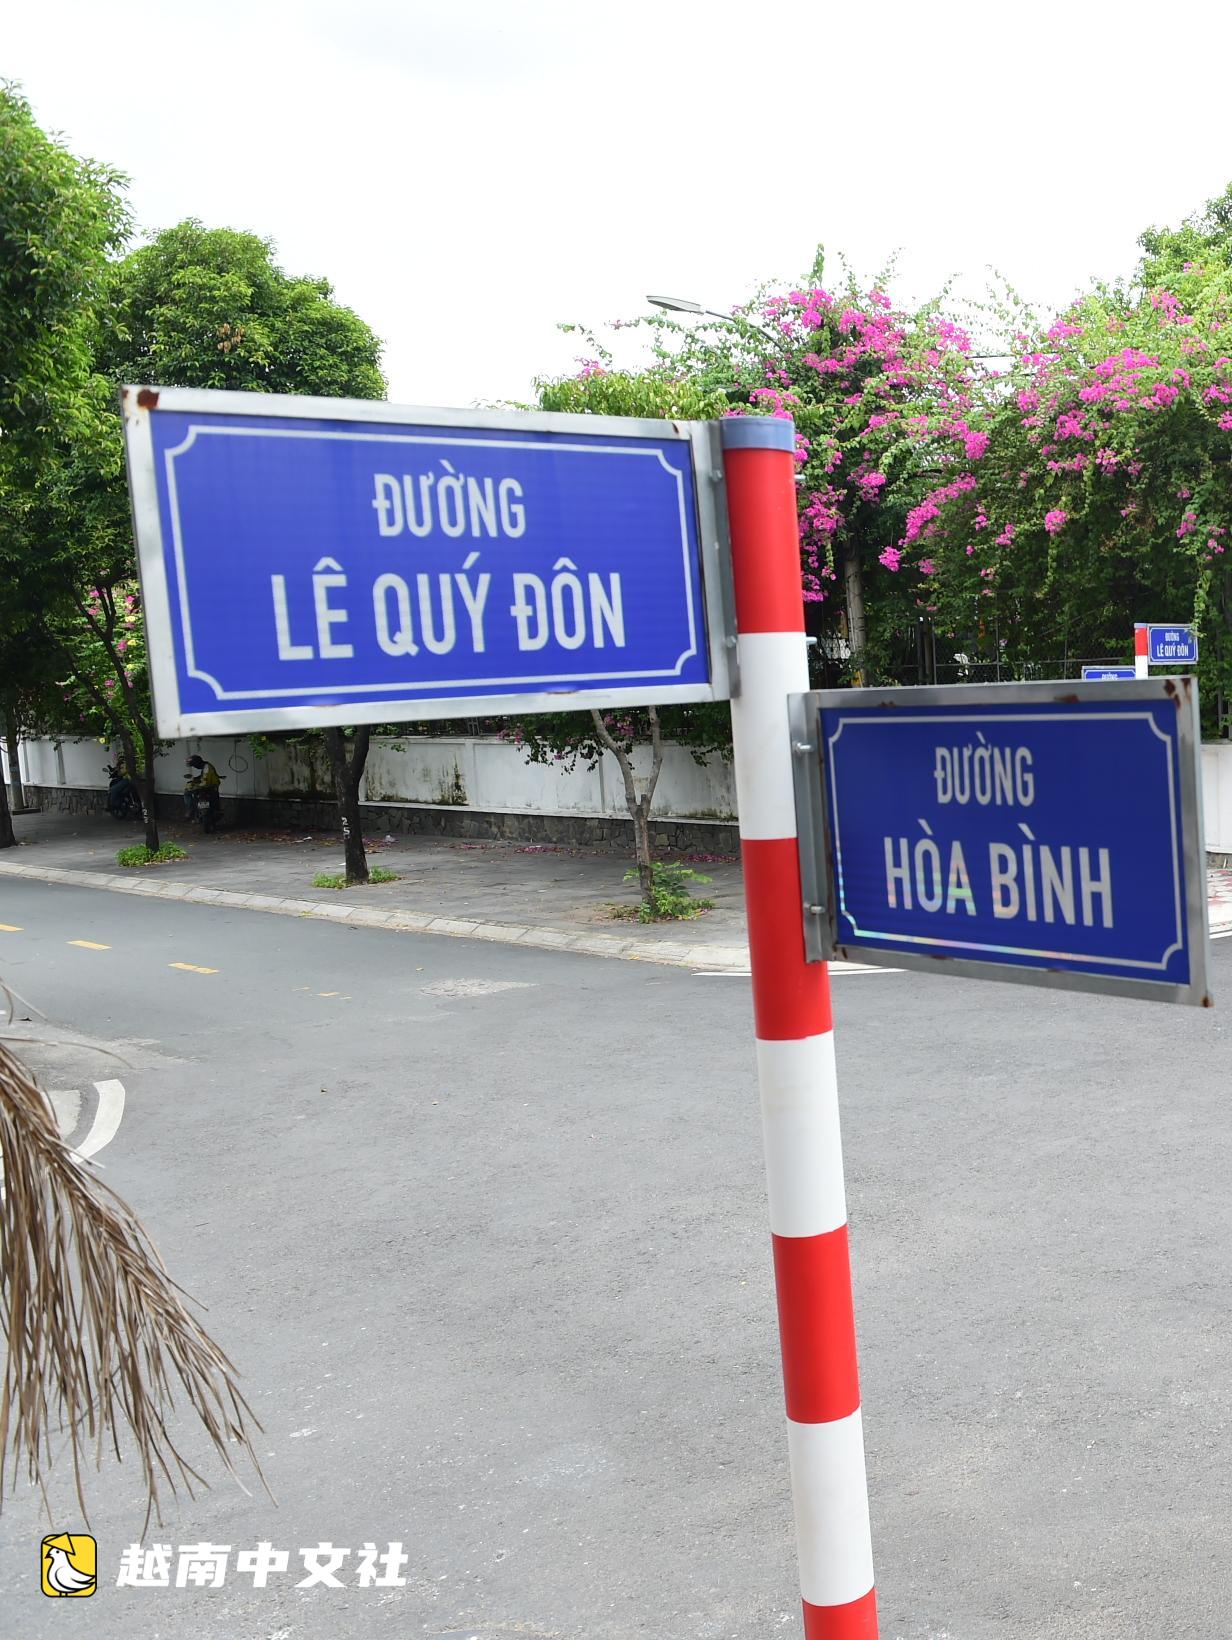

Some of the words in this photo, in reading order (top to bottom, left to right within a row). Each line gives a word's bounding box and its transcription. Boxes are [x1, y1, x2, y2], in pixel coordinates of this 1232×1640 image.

[372, 459, 527, 538] ĐƯỜNG
[271, 556, 354, 661] LÊ
[372, 551, 491, 658] QUÝ
[510, 557, 626, 652] ĐÔN
[1156, 643, 1164, 657] LÊ
[1164, 642, 1177, 657] QUÝ
[1177, 643, 1189, 657] ĐÔN
[934, 731, 1035, 807] ĐƯỜNG
[883, 818, 977, 916] HÒA
[989, 822, 1113, 929] BÌNH
